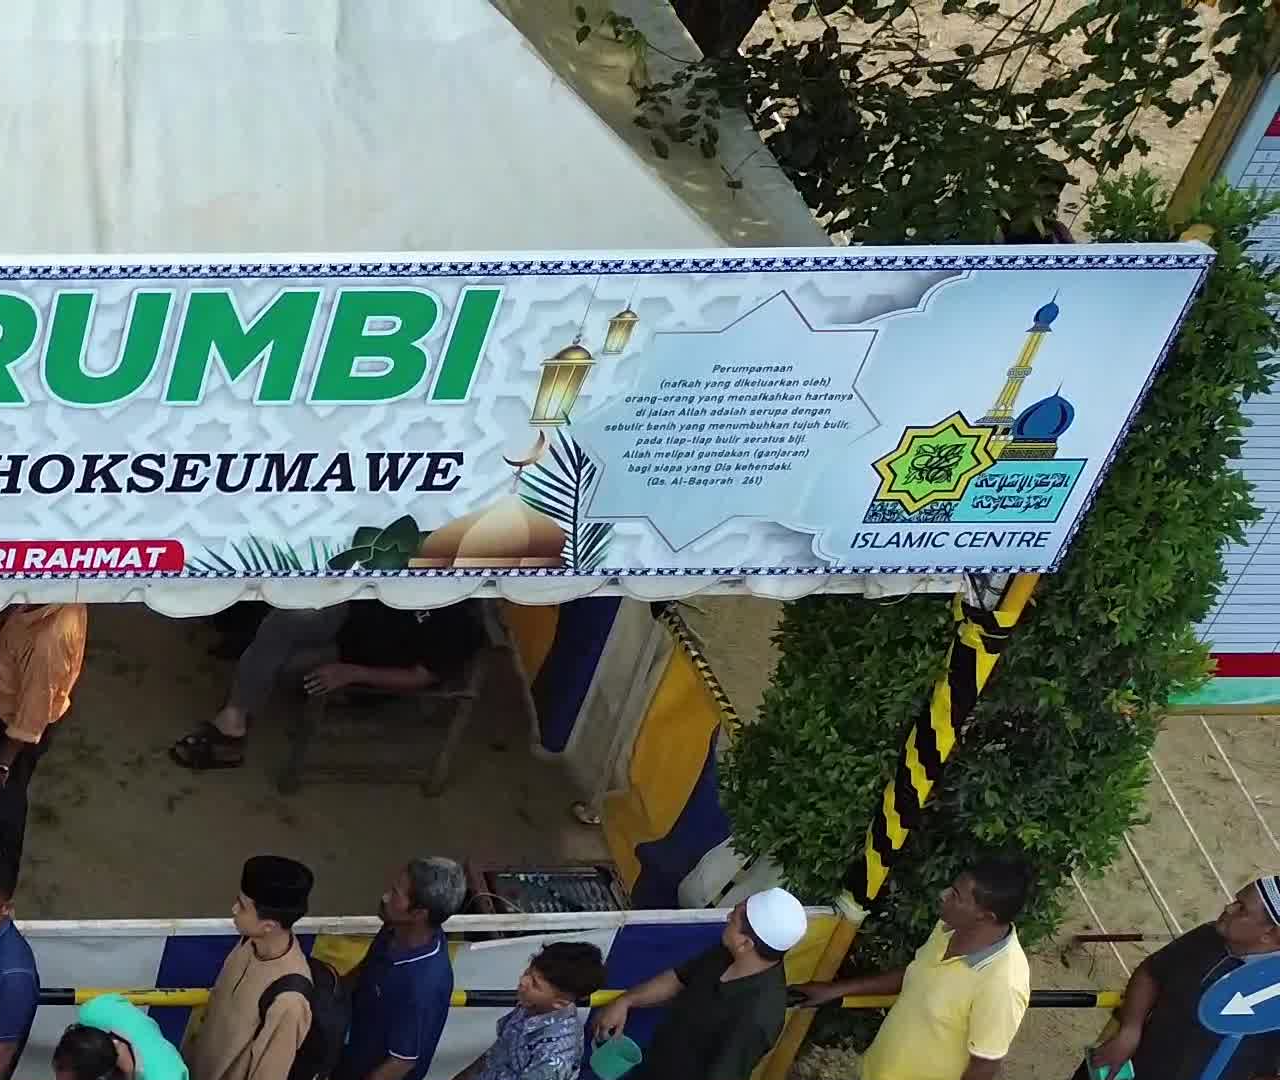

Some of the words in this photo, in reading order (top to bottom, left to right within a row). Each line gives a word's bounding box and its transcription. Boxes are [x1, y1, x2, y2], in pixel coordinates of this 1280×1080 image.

[712, 364, 793, 375] Perumpamaan
[704, 380, 731, 390] yang
[625, 395, 695, 404] orang-orang
[697, 395, 724, 404] yang
[805, 393, 854, 402] hartanya
[647, 409, 675, 418] jalan
[678, 408, 707, 417] Allah
[749, 407, 788, 417] serupa
[791, 407, 831, 417] dengan
[604, 422, 644, 431] sebutir
[646, 422, 676, 431] benih
[678, 423, 706, 432] yang
[707, 421, 789, 430] menumbuhkan
[792, 421, 820, 431] tujuh
[635, 437, 662, 446] pada
[666, 436, 712, 446] tiap-tiap
[715, 435, 741, 444] bulir
[743, 435, 785, 444] seratus
[622, 450, 651, 459] Allah
[654, 450, 695, 460] melipat
[697, 449, 750, 460] gandakan
[753, 448, 810, 459] (ganjaran)
[627, 464, 651, 474] bagi
[653, 464, 682, 473] siapa
[684, 464, 711, 474] yang
[714, 463, 732, 472] Dia
[670, 476, 734, 487] Al-Baqarah
[850, 531, 950, 549] ISLAMIC
[953, 531, 1052, 549] CENTRE
[24, 546, 167, 570] RAHMAT
